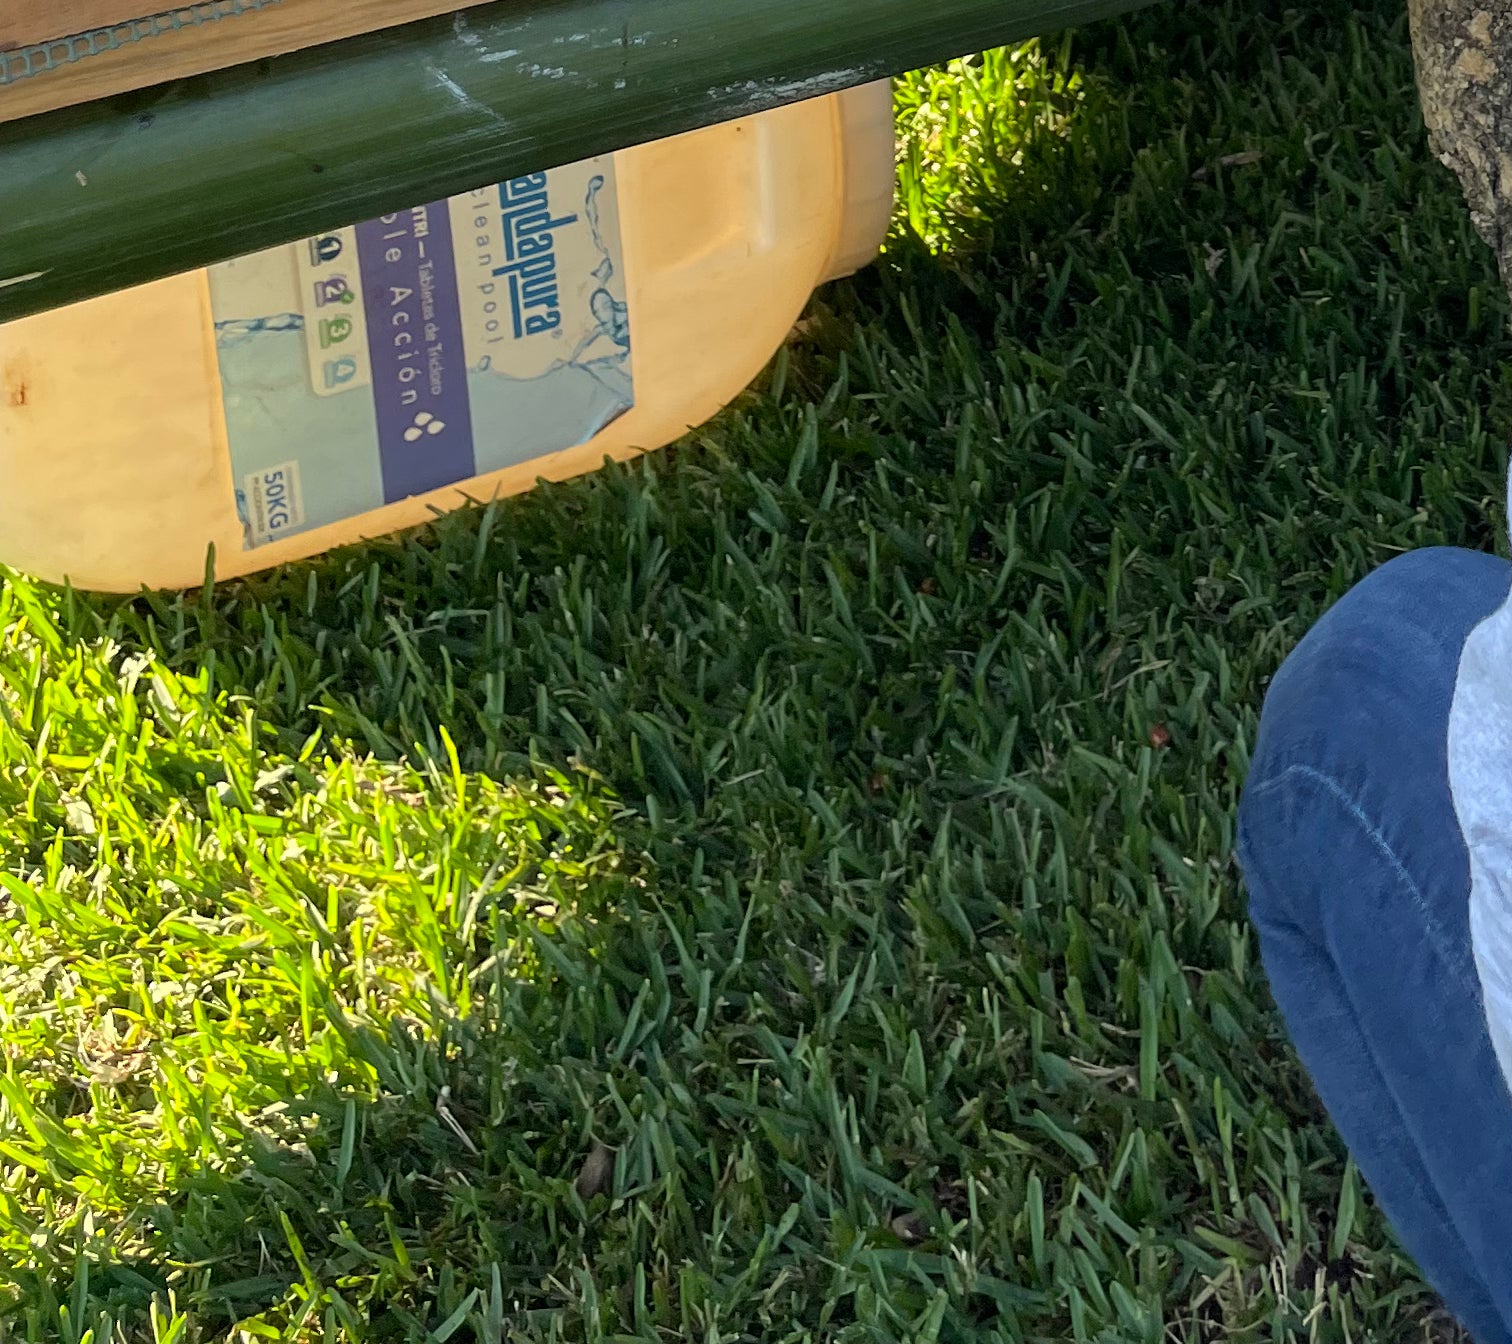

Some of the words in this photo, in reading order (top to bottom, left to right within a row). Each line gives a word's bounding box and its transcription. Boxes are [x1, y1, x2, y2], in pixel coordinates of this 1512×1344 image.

[418, 259, 436, 321] Tabletas
[477, 282, 504, 345] pool
[388, 285, 423, 406] Acción
[423, 322, 441, 342] de
